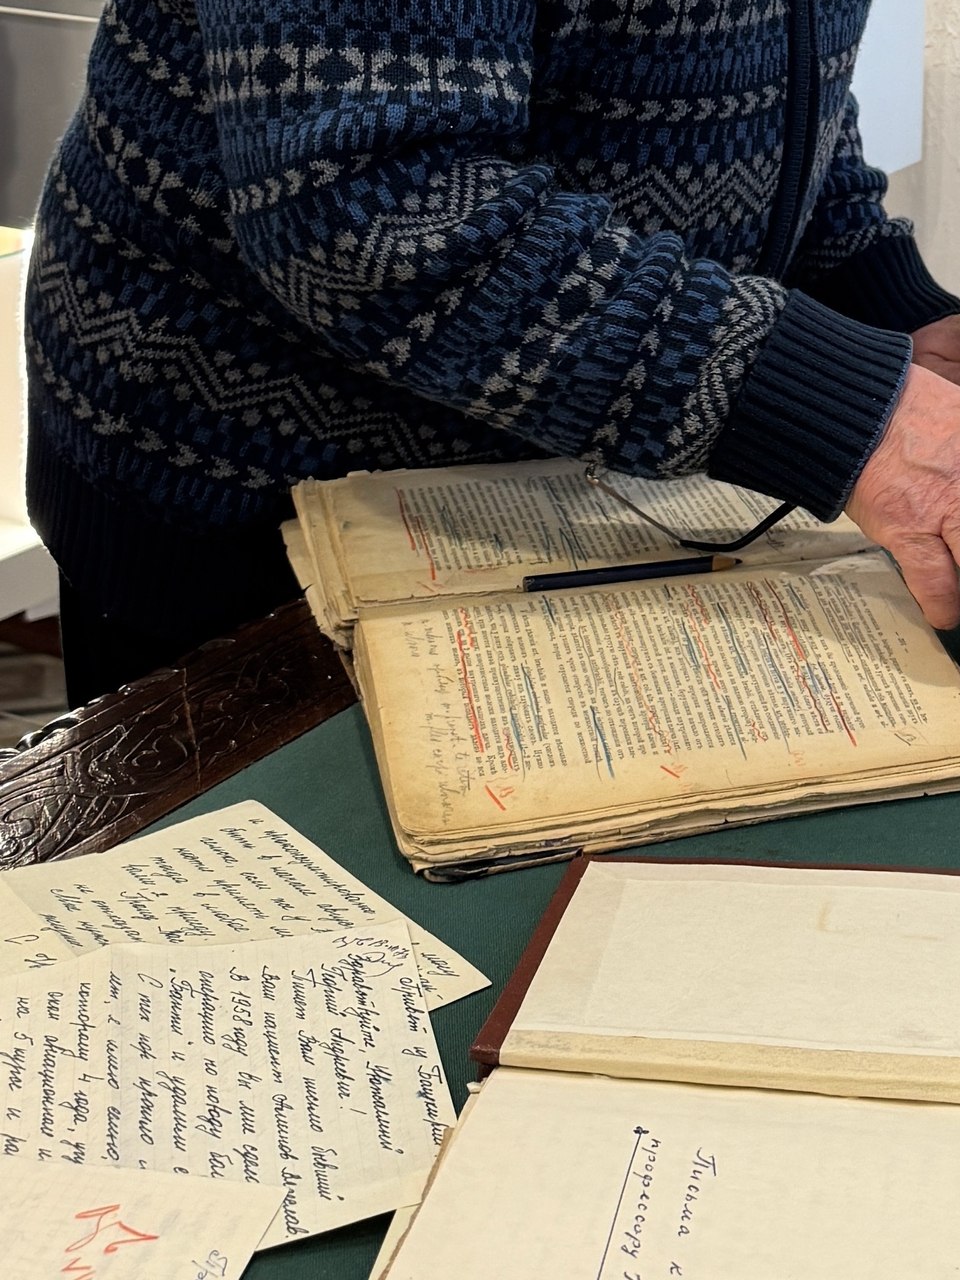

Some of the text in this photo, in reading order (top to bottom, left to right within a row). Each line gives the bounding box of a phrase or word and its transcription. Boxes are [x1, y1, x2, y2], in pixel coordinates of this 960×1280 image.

[50, 889, 83, 912] Мне
[74, 884, 94, 894] не
[151, 857, 188, 884] тогда
[201, 903, 250, 932] любое
[240, 872, 271, 890] если
[270, 866, 316, 896] начале
[104, 971, 122, 1004] лет,
[230, 967, 250, 981] В
[262, 965, 280, 1001] Ваш
[315, 964, 348, 1017] Георгий
[16, 997, 30, 1019] на
[62, 982, 96, 1061] которому
[193, 970, 219, 1045] операцию
[230, 991, 253, 1026] 1958
[391, 977, 427, 1034] Привет
[14, 1032, 33, 1046] 5
[172, 1051, 185, 1060] и
[221, 1027, 248, 1056] году
[263, 1012, 282, 1083] пациент
[339, 954, 380, 1053] Здравствуйте,
[366, 1061, 404, 1154] Уважаемый
[402, 1047, 428, 1058] из
[78, 1073, 104, 1083] 4
[107, 1040, 119, 1089] имею
[130, 973, 164, 1145] С тех пор прошло
[204, 1058, 218, 1076] по
[38, 1035, 67, 1138] авиационном
[292, 969, 344, 1201] Пишет Вам письмо бывший
[6, 1107, 22, 1120] и
[58, 1090, 89, 1132] года,
[157, 1071, 188, 1151] удалили
[195, 1085, 232, 1139] поводу
[239, 1100, 256, 1134] мне
[101, 1106, 121, 1161] семью,
[620, 1138, 662, 1259] профессору
[669, 1146, 717, 1276] Письма к
